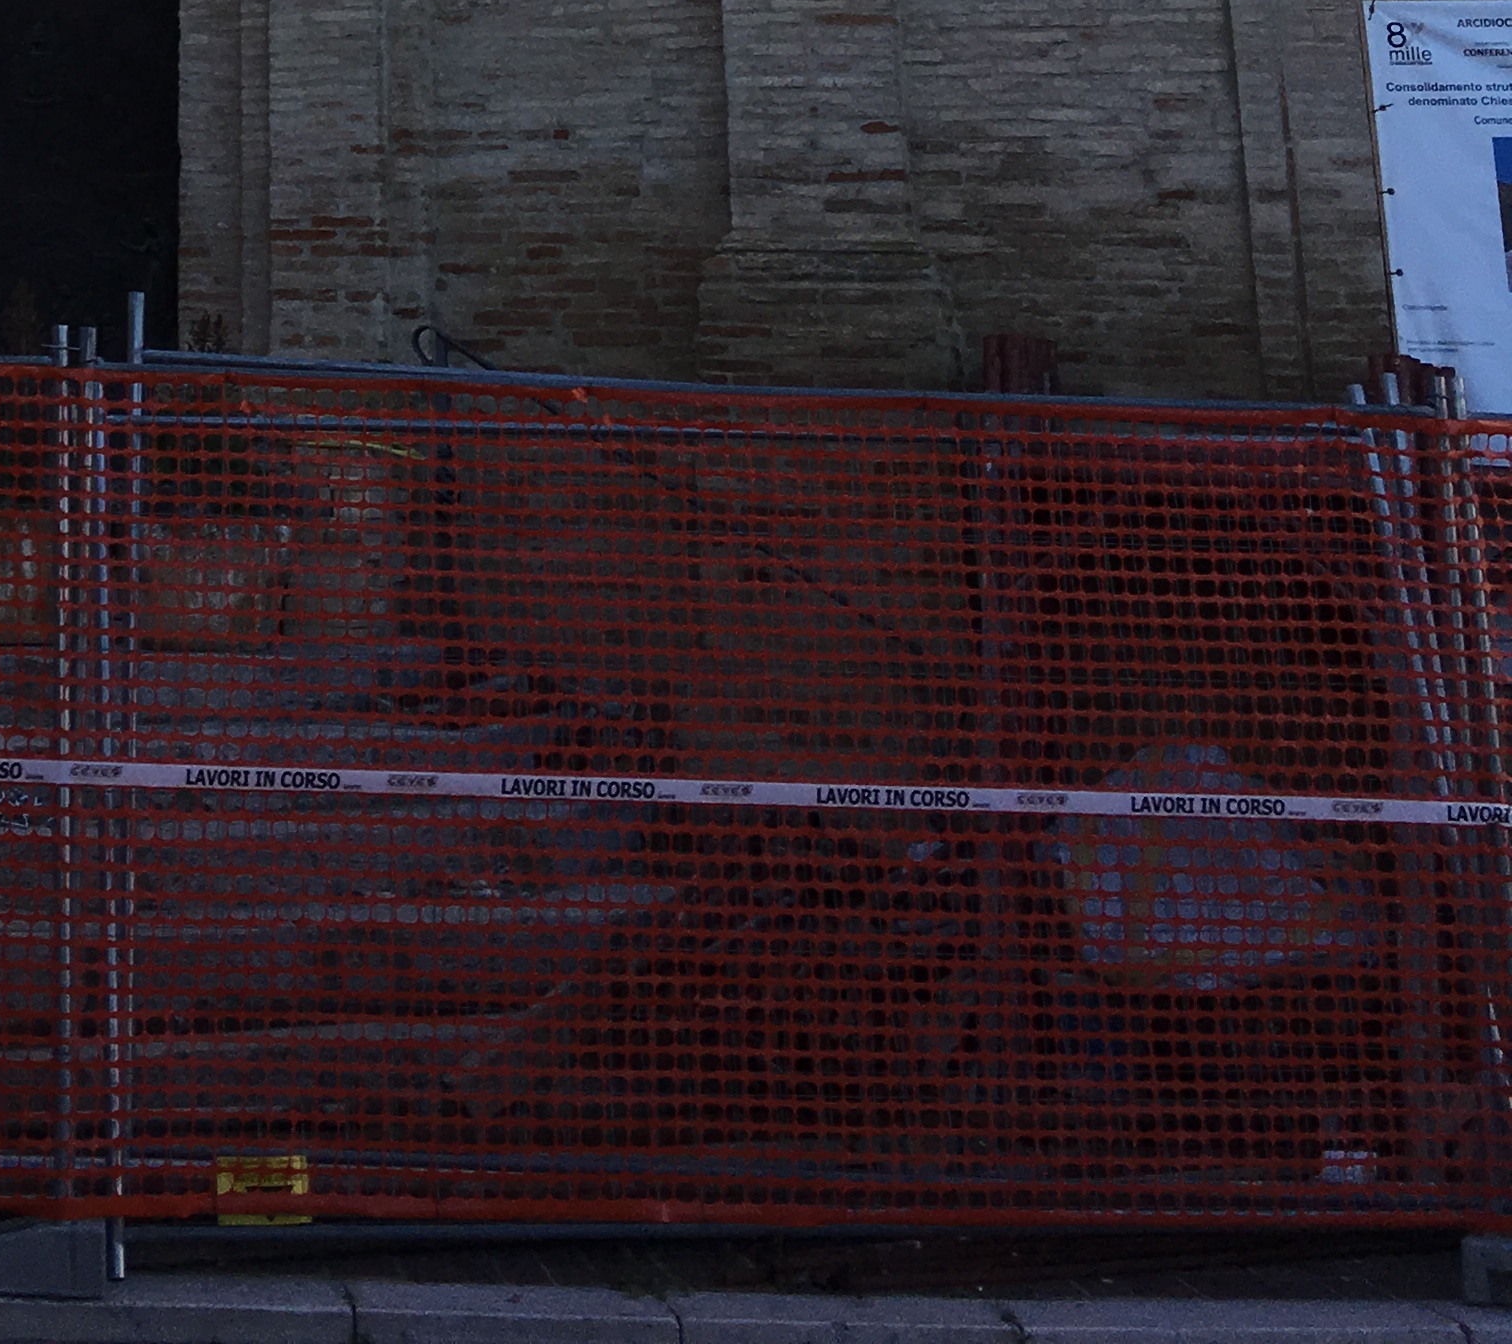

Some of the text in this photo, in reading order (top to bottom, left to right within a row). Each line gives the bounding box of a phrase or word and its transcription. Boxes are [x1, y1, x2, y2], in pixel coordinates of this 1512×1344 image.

[1389, 45, 1432, 61] mille
[1386, 82, 1482, 92] Consolidamento
[1408, 96, 1477, 106] denominato
[186, 769, 250, 786] LAVORI
[255, 771, 275, 787] IN
[281, 771, 340, 789] CORSO
[501, 778, 566, 796] LAVORI
[571, 780, 591, 797] IN
[597, 781, 655, 799] CORSO
[817, 788, 880, 805] LAVORI
[885, 790, 905, 806] IN
[910, 790, 970, 808] CORSO
[1131, 797, 1194, 814] LAVORI
[1199, 798, 1221, 814] IN
[1226, 798, 1285, 815] CORSO
[1448, 805, 1510, 823] LAVORI
